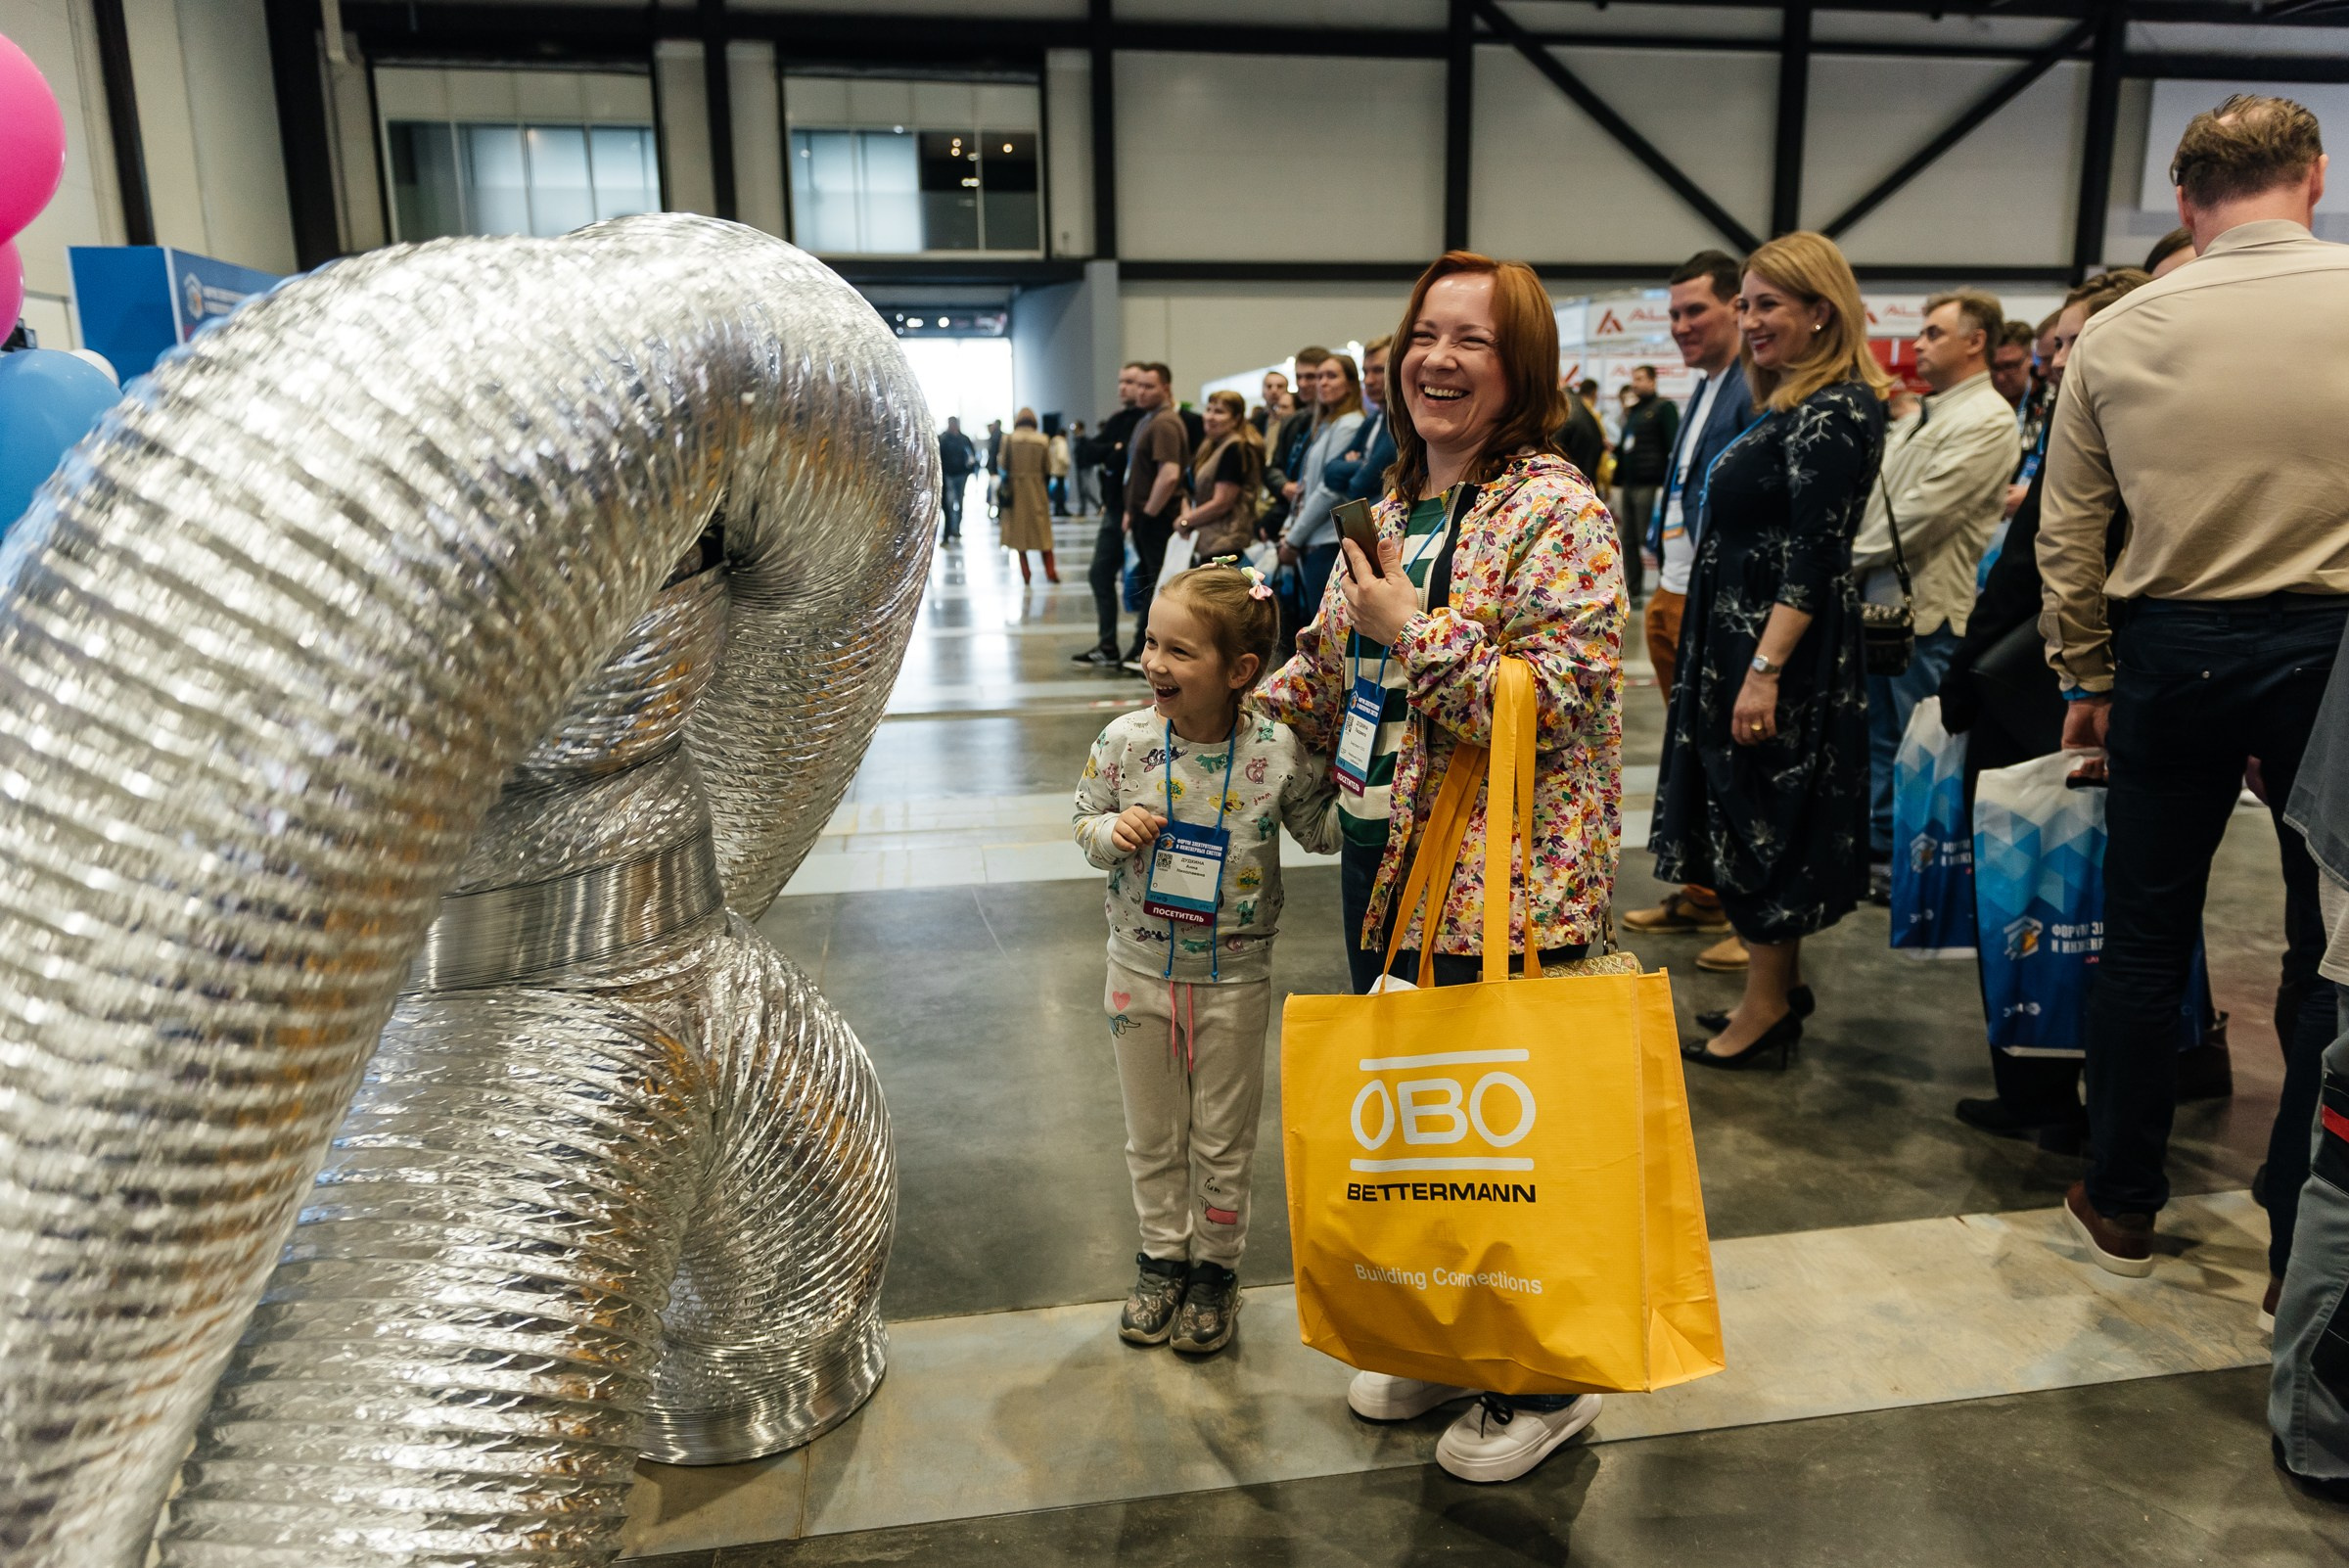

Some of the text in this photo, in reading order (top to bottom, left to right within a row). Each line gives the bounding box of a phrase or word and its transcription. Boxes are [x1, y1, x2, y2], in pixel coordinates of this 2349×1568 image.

[1153, 906, 1204, 923] ПОСЕТИТЕЛЬ
[2051, 923, 2089, 939] ФОРУМ
[1350, 1071, 1537, 1151] OBO
[1347, 1182, 1537, 1203] BETTERMANN
[1355, 1264, 1543, 1295] Building Connections
